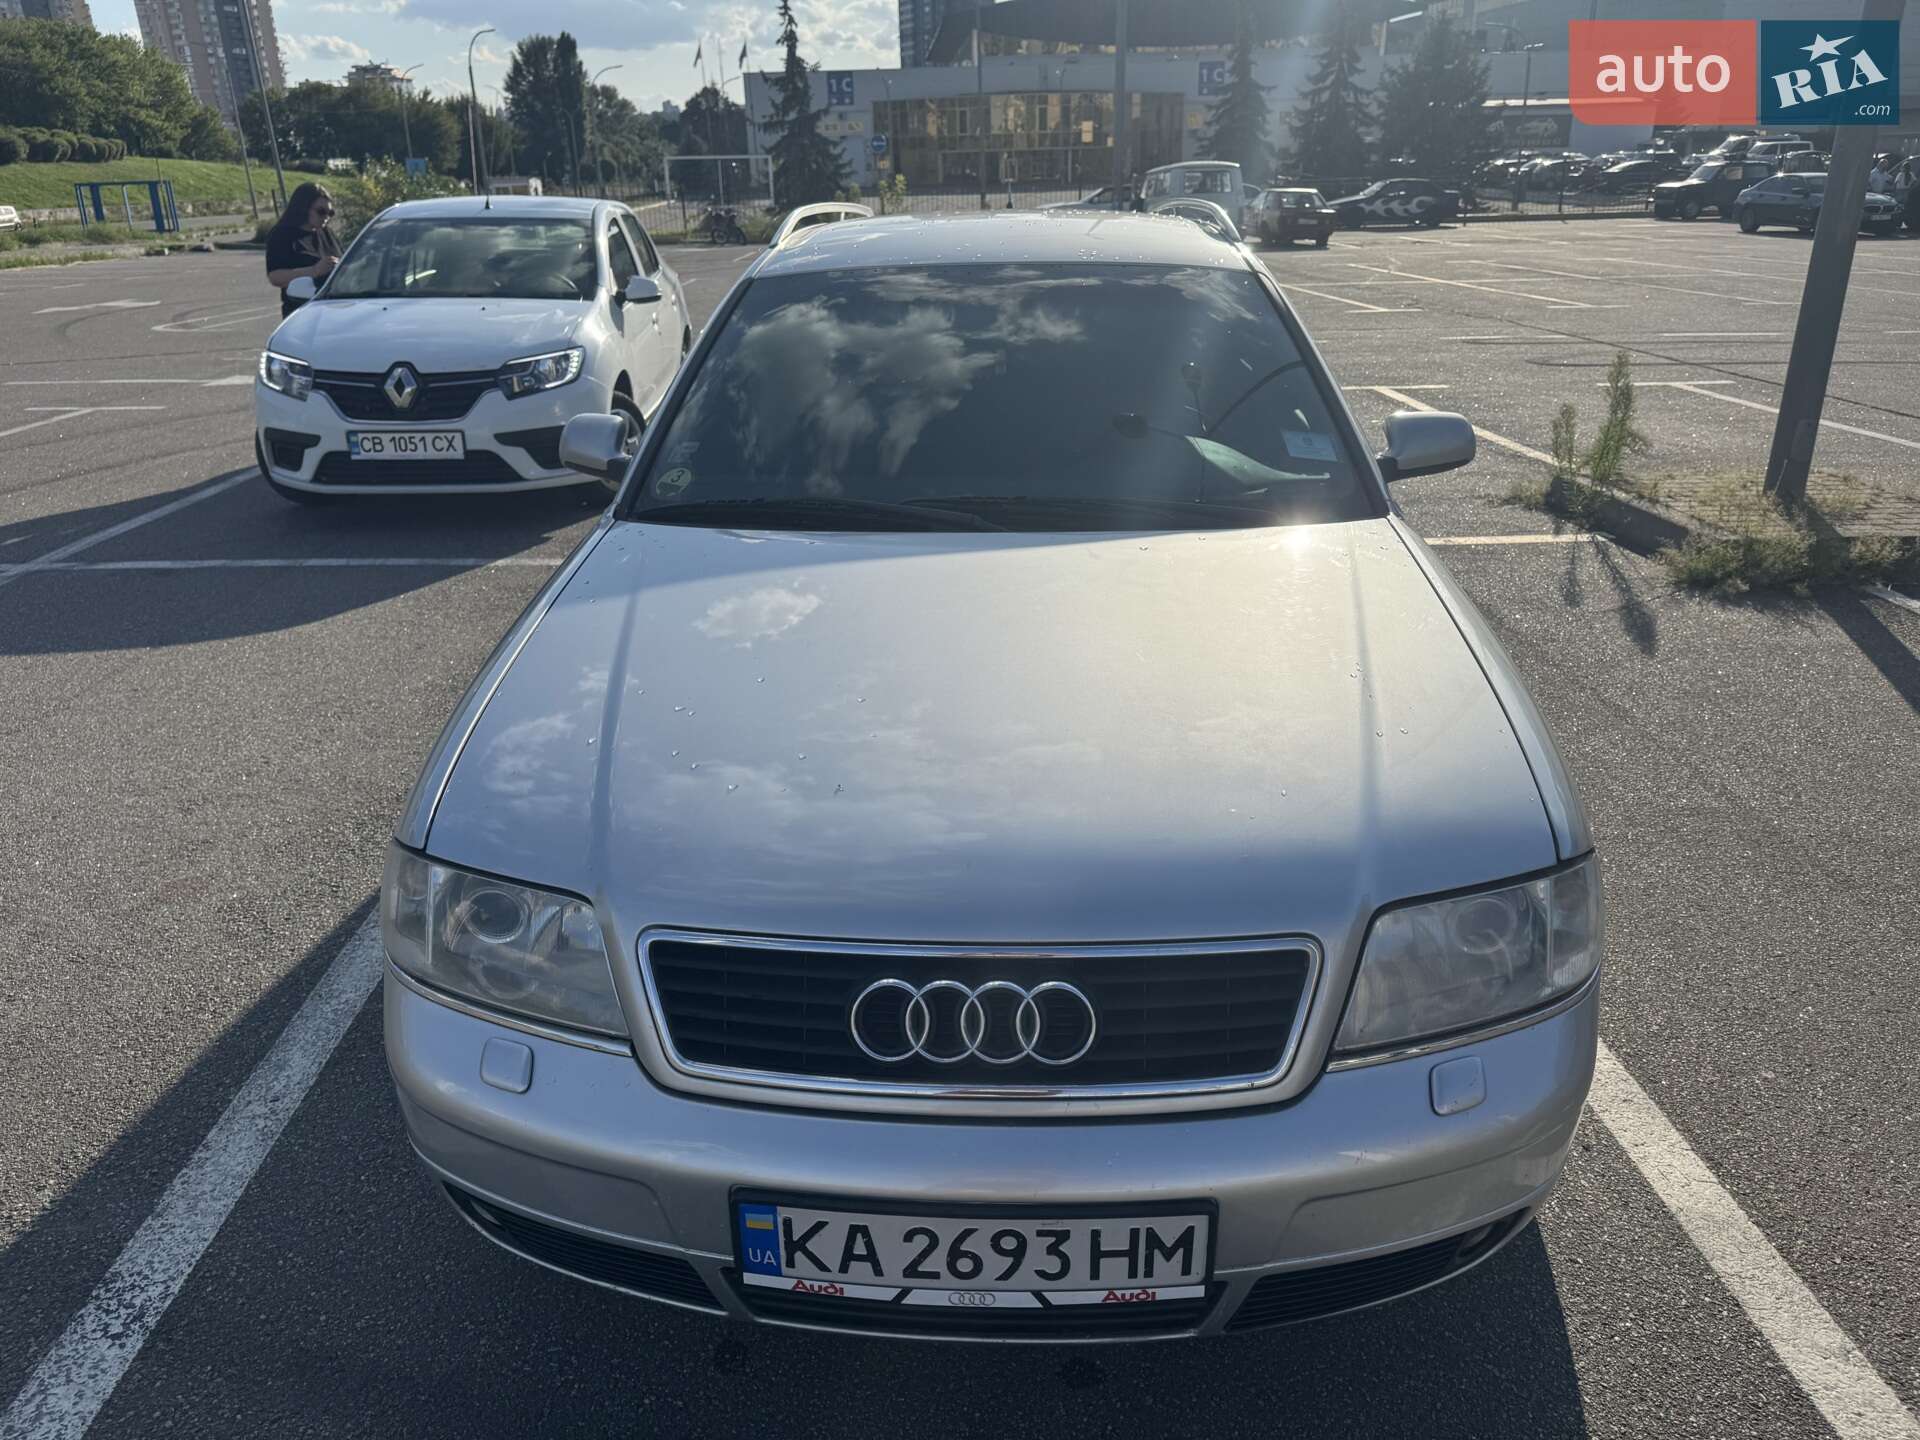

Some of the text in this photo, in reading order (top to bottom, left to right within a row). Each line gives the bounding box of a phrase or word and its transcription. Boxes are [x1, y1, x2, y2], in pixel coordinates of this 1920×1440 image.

[360, 434, 457, 453] CB 1051 CX
[748, 1247, 777, 1267] UA
[782, 1215, 1195, 1282] KA 2693 HM
[791, 1279, 845, 1296] Audi
[1102, 1289, 1156, 1303] Audi
